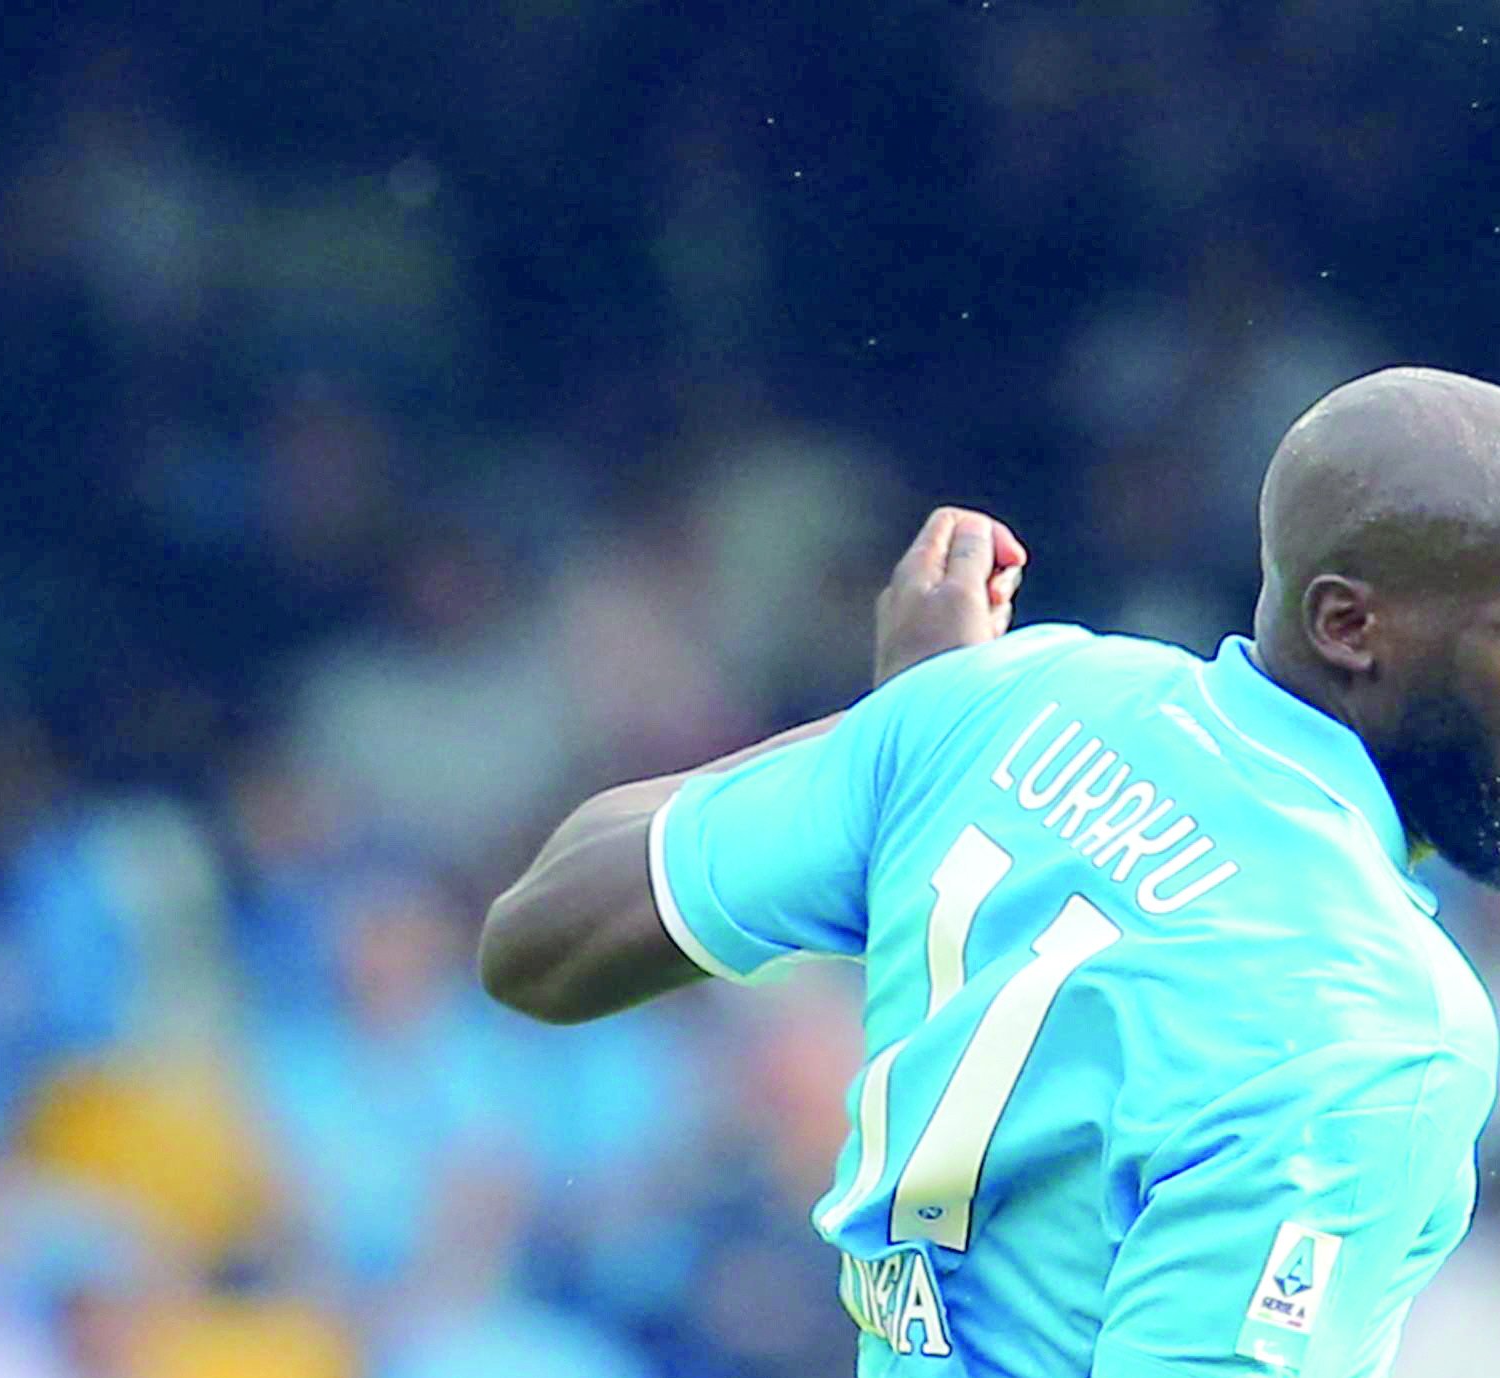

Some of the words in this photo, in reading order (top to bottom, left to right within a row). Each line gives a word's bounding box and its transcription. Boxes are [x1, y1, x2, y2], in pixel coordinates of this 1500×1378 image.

[989, 700, 1242, 915] LUKAKU
[817, 822, 1124, 1252] 11
[1261, 1296, 1295, 1316] SERIE
